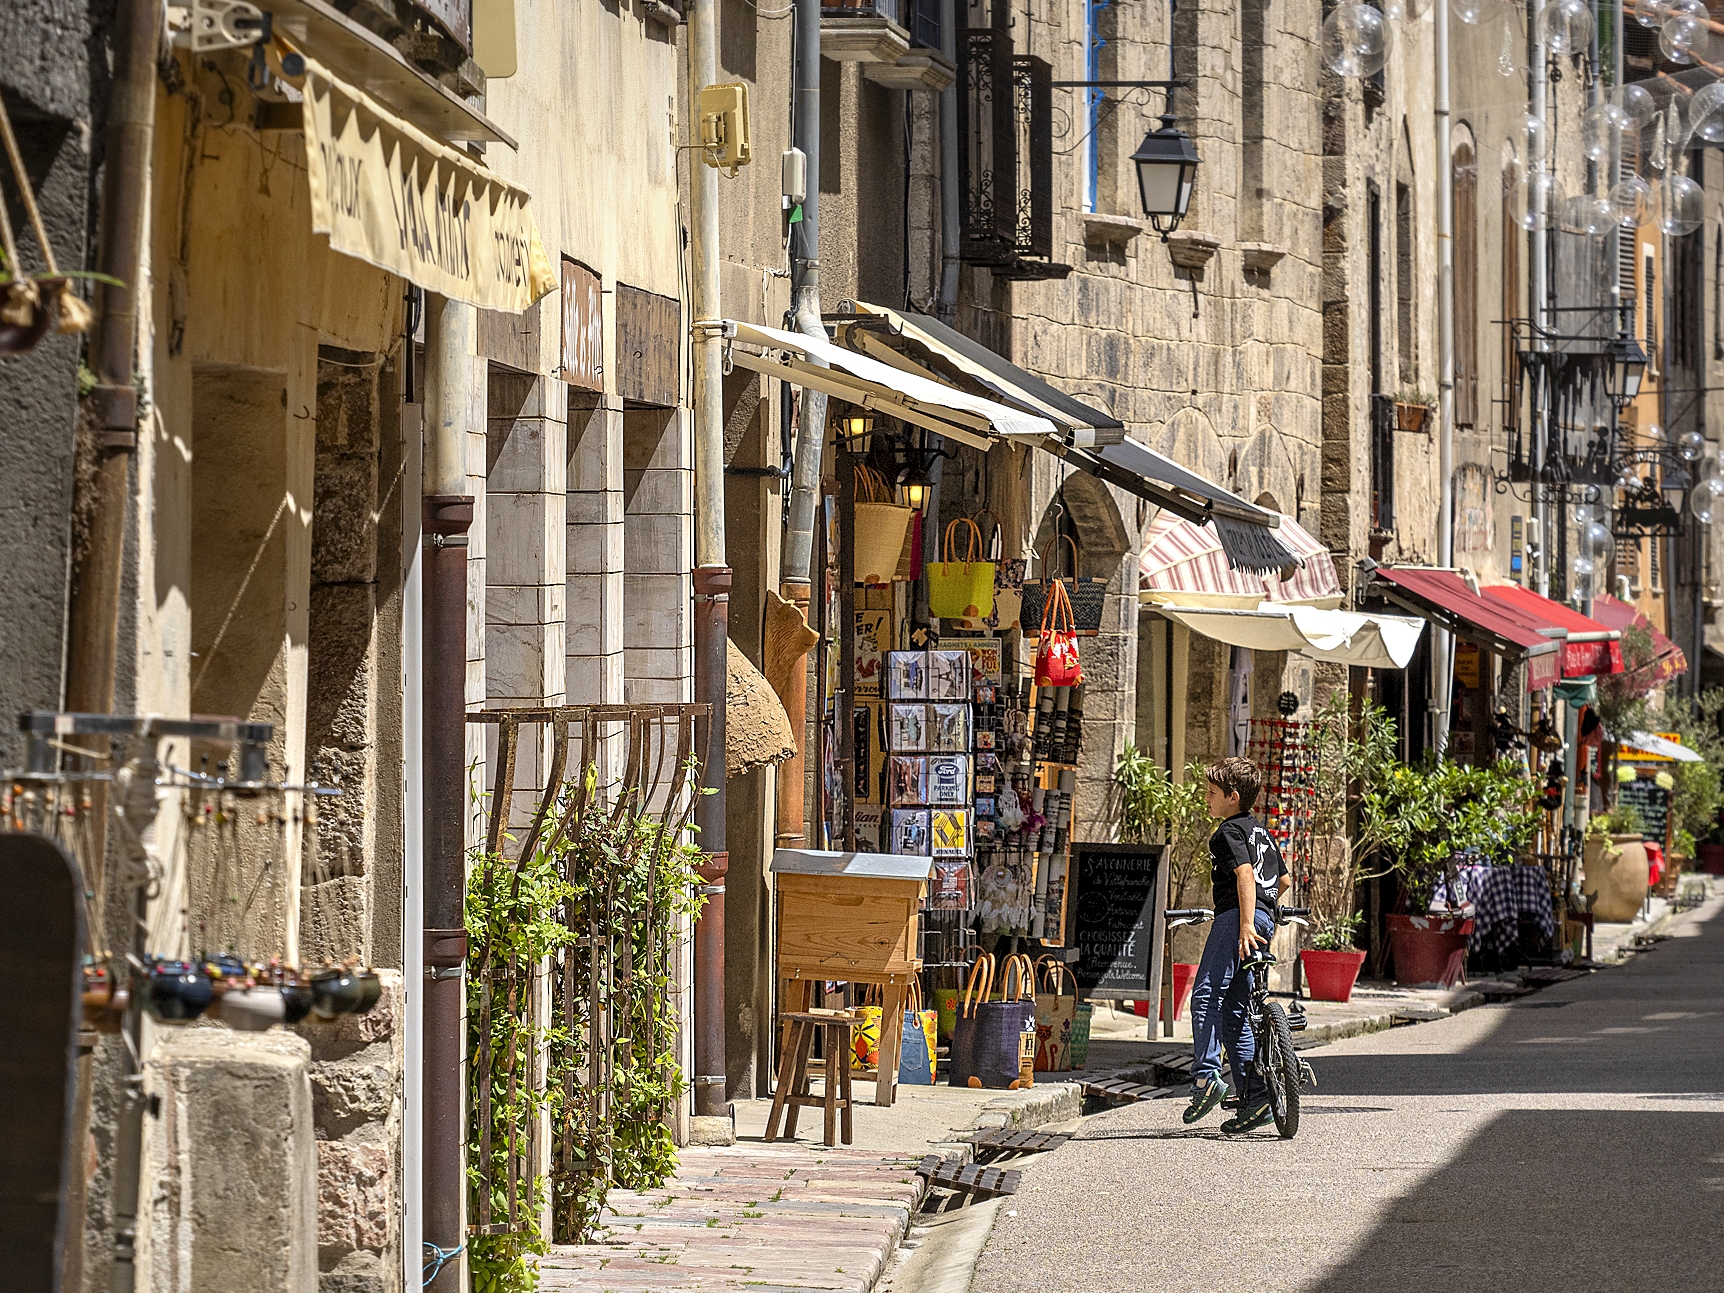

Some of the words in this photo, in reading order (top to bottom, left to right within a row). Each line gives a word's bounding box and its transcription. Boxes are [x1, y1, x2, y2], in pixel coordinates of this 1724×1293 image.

[937, 765, 958, 776] Ford
[933, 784, 960, 792] PARKING
[1082, 854, 1153, 877] SAVONNERIE
[1079, 930, 1136, 943] CHOISISSEZ
[1080, 943, 1091, 956] LA
[1093, 942, 1136, 957] QUALITÉ
